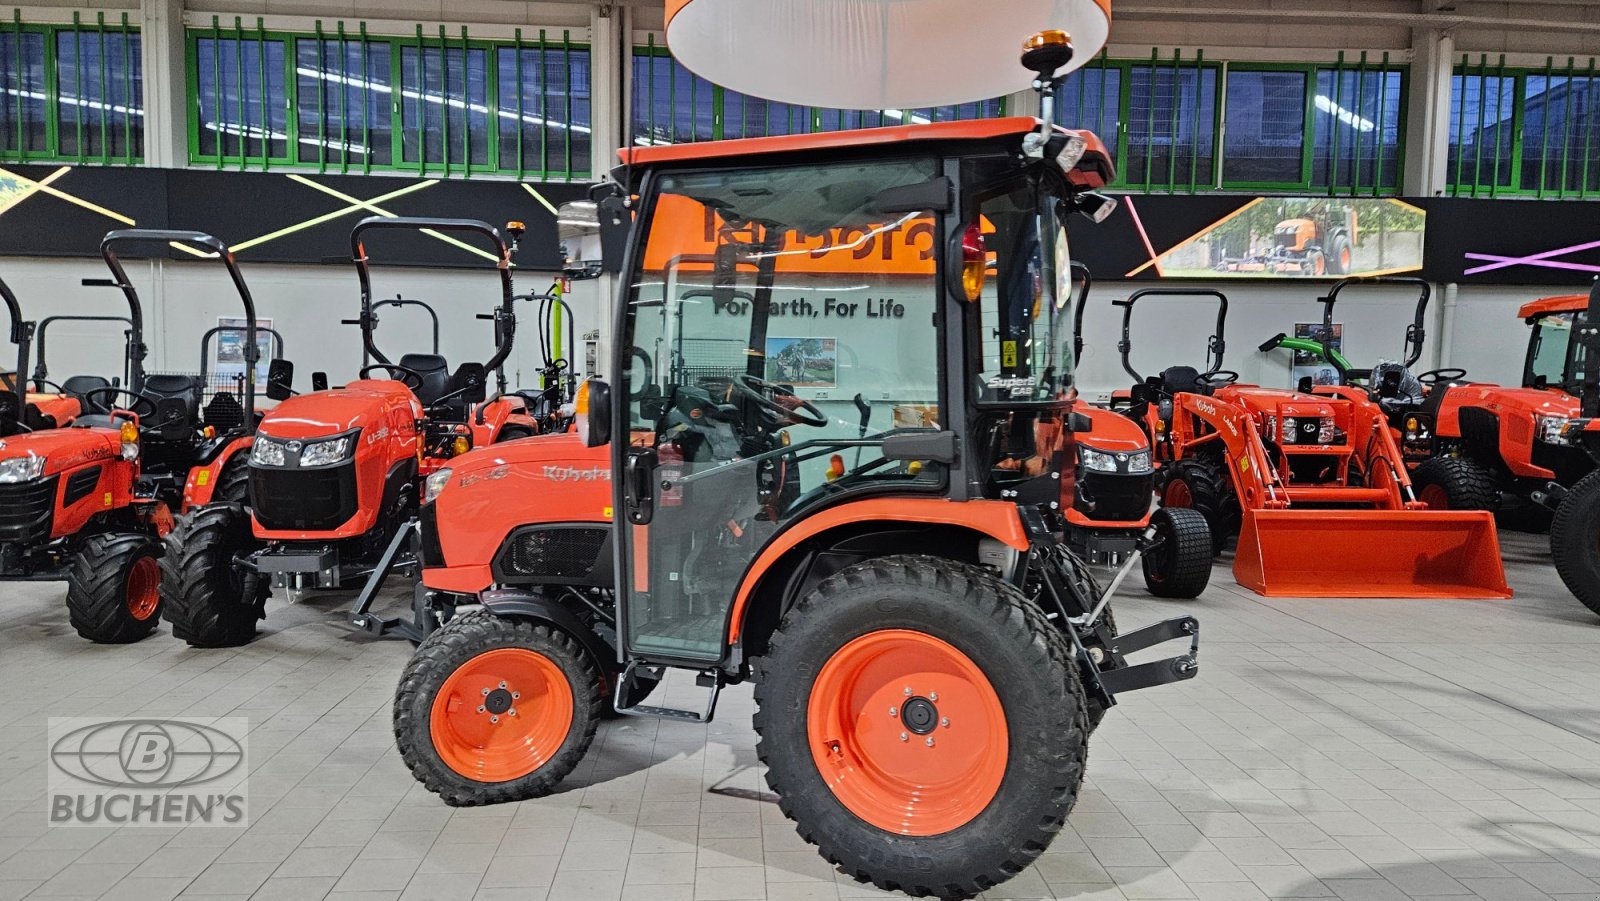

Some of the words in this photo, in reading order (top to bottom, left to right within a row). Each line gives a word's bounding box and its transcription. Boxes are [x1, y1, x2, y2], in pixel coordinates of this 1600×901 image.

[714, 299, 749, 315] For
[767, 298, 819, 318] arth,
[824, 298, 858, 317] For
[867, 298, 905, 317] Life
[1196, 399, 1216, 416] Kubota
[542, 465, 612, 481] Kubota
